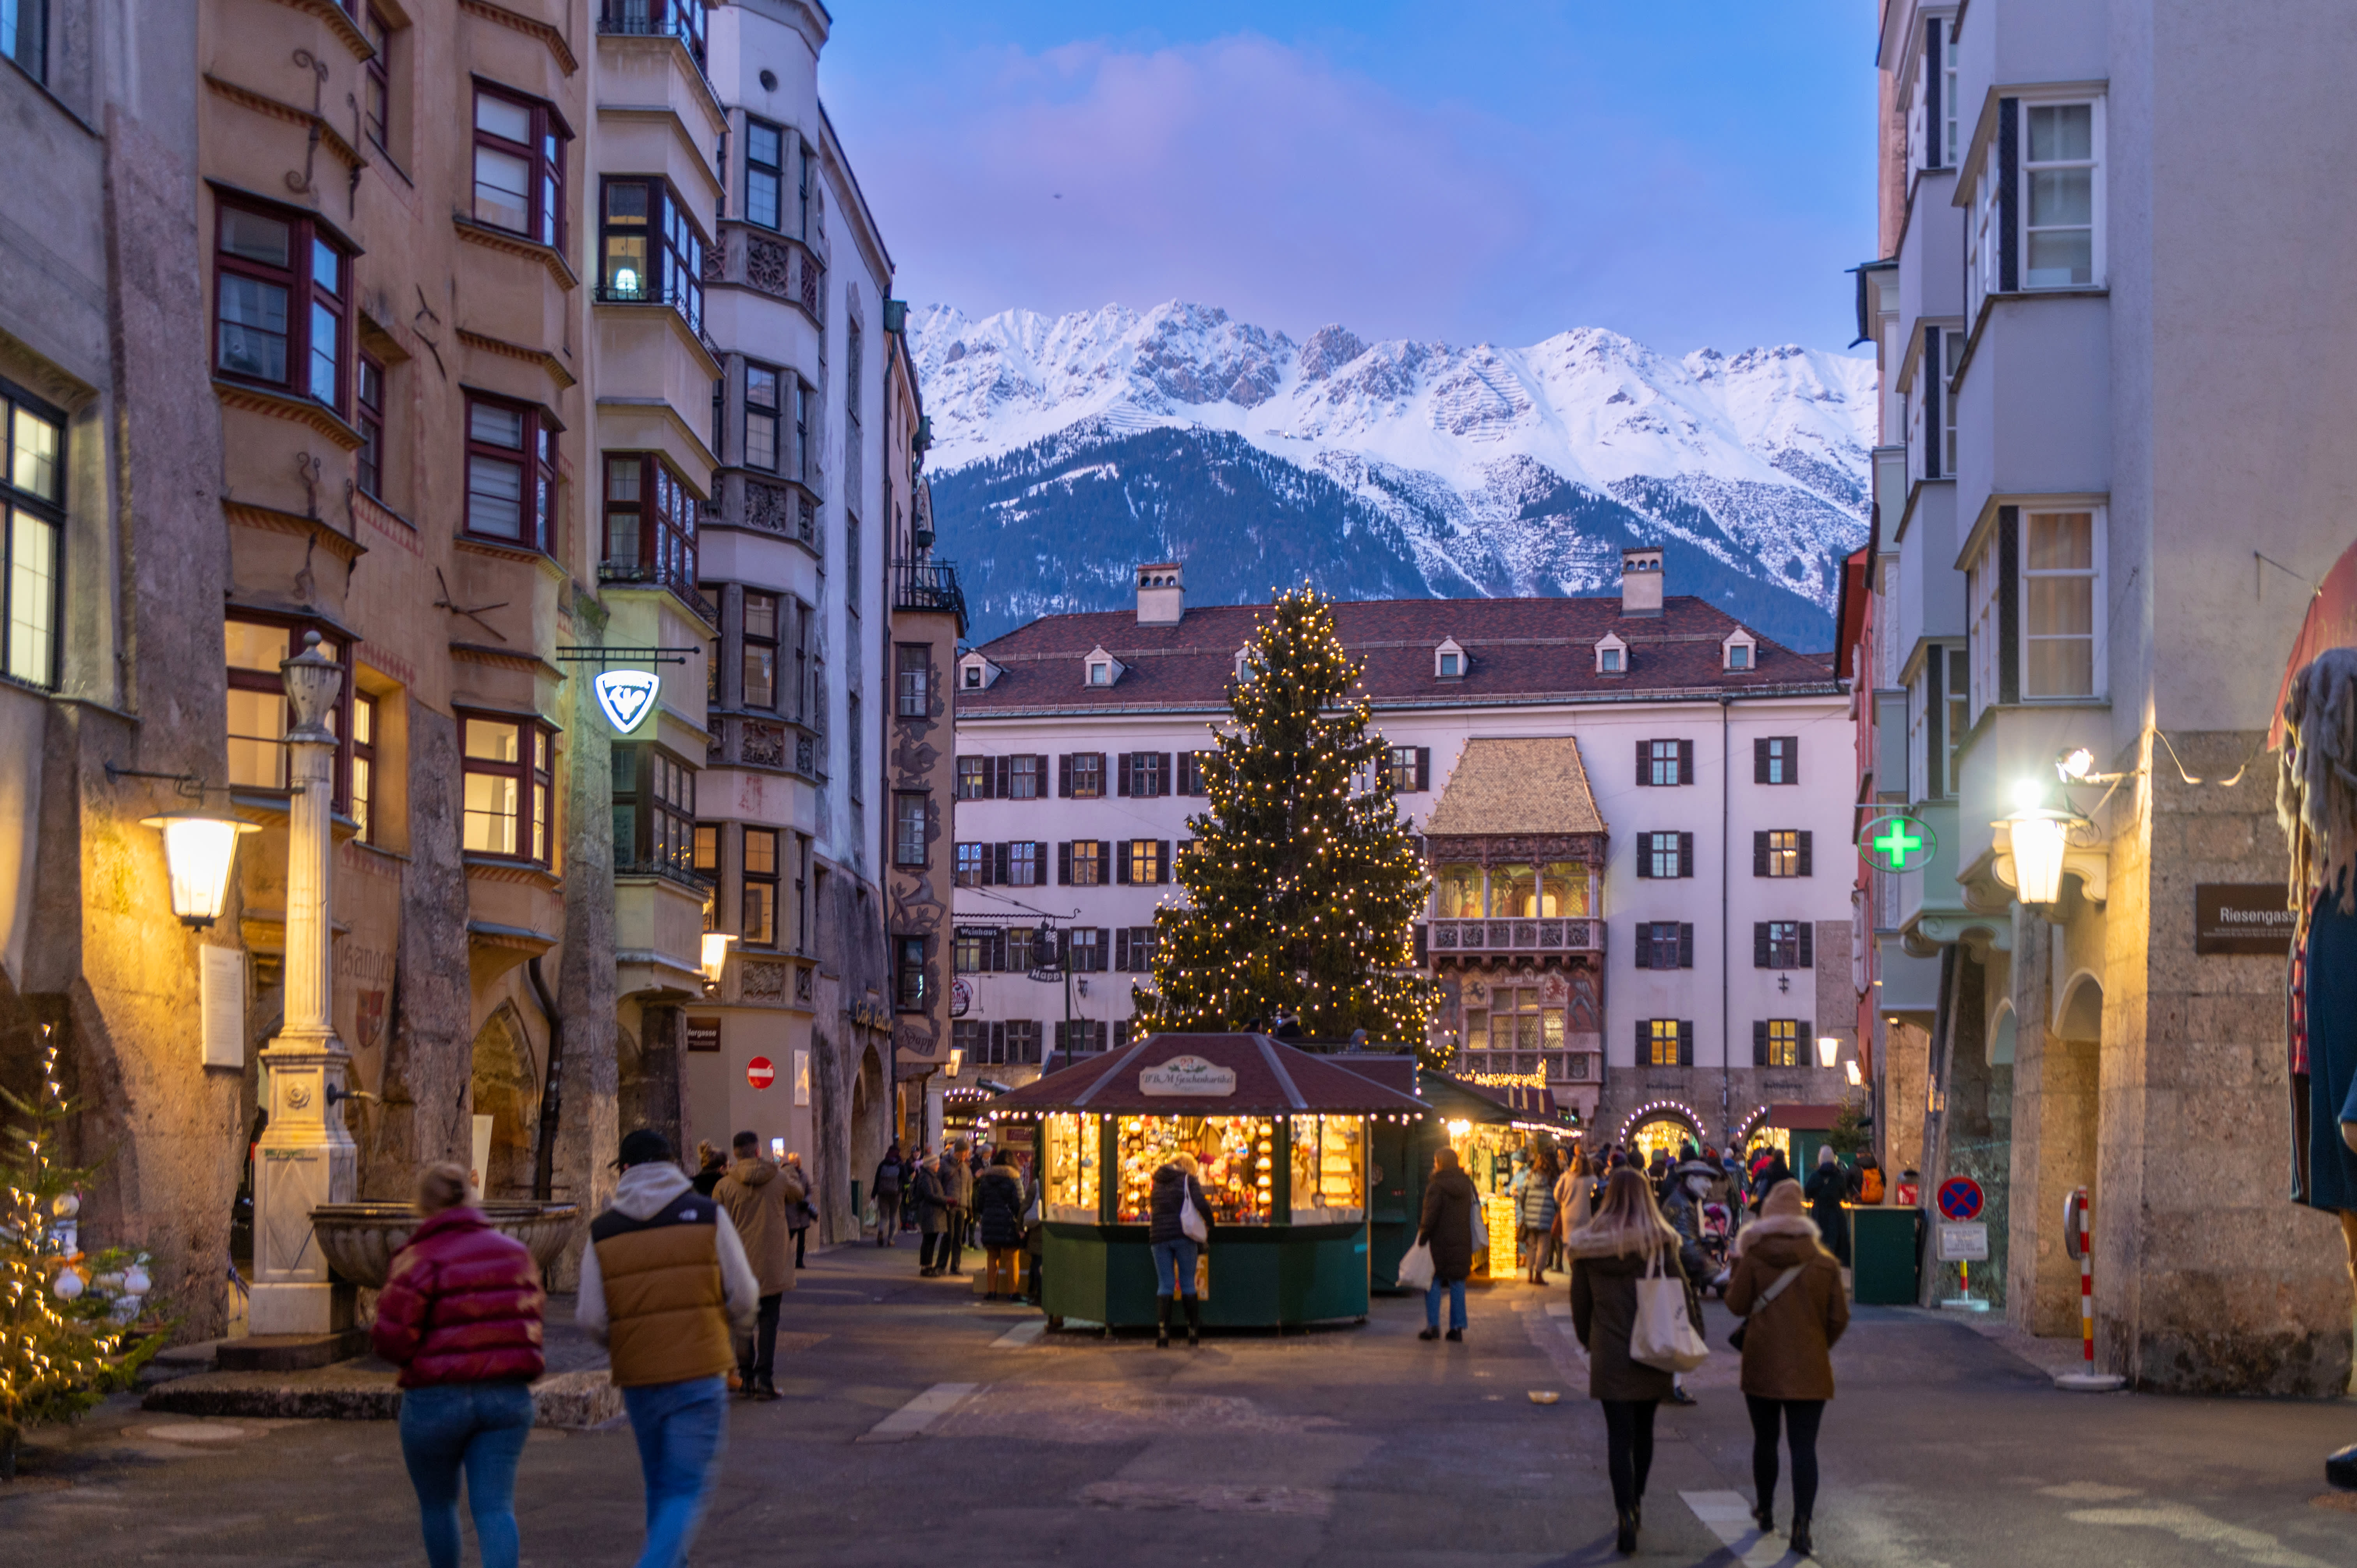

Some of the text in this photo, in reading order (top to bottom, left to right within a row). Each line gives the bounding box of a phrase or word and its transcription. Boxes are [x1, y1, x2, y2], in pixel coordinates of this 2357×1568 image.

[2220, 907, 2297, 926] Riesengass
[961, 927, 997, 936] Weinhaus
[1031, 968, 1060, 981] Happ
